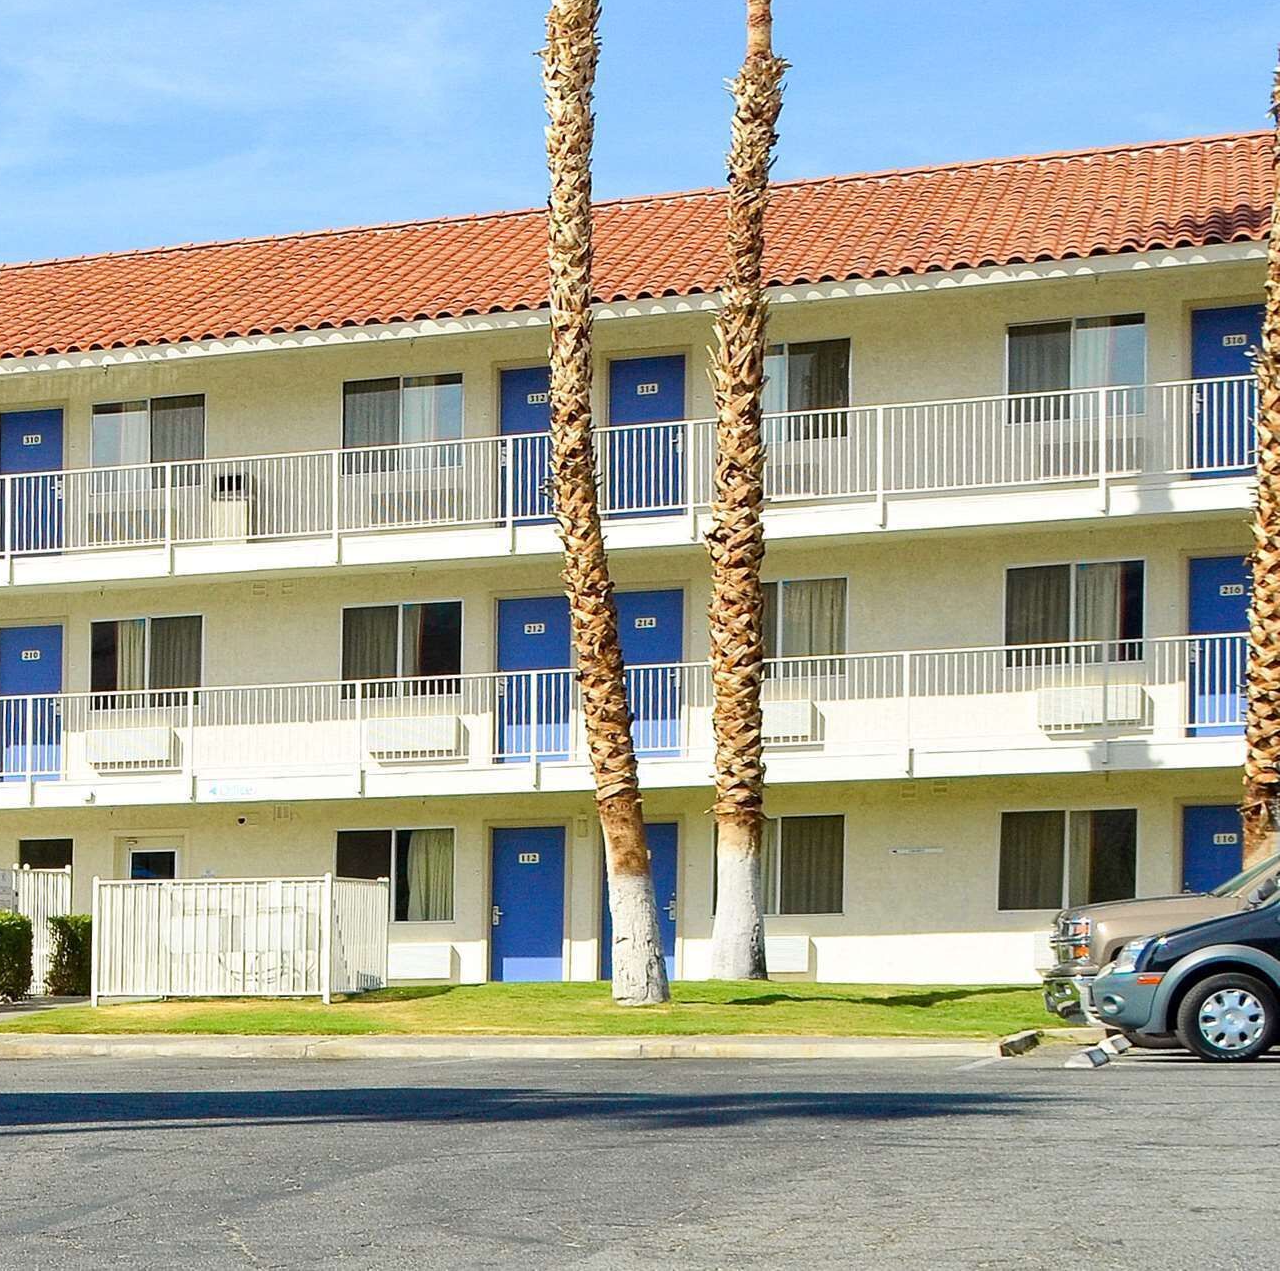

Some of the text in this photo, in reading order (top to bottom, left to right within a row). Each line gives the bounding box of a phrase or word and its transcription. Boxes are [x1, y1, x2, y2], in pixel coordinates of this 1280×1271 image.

[1225, 336, 1242, 345] 316
[639, 385, 655, 394] 314
[529, 395, 545, 403] 312
[25, 436, 39, 444] 310
[1222, 586, 1240, 594] 216
[638, 619, 654, 627] 214
[527, 625, 542, 633] 212
[1216, 834, 1234, 843] 116
[521, 854, 536, 862] 112
